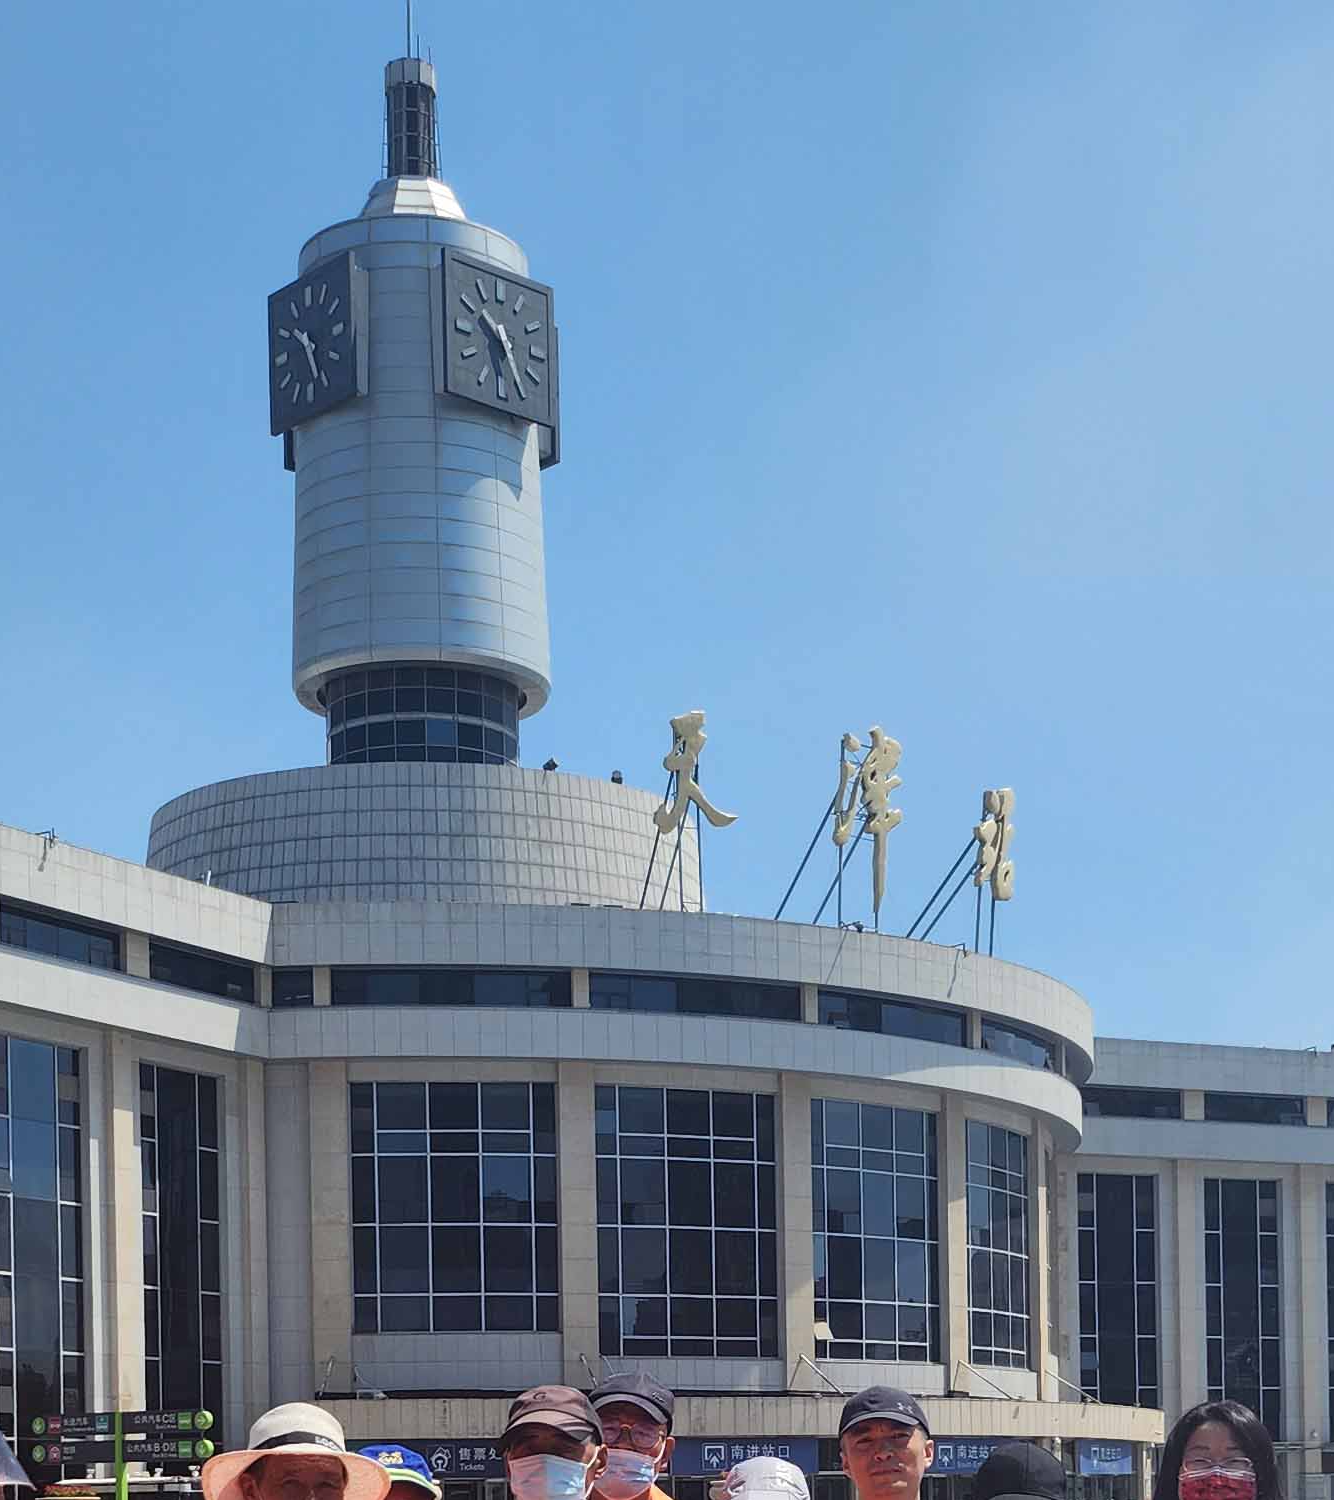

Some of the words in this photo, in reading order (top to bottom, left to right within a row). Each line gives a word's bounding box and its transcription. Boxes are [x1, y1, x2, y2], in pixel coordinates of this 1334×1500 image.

[730, 1443, 790, 1460] 南进站口
[459, 1463, 485, 1471] Tickets
